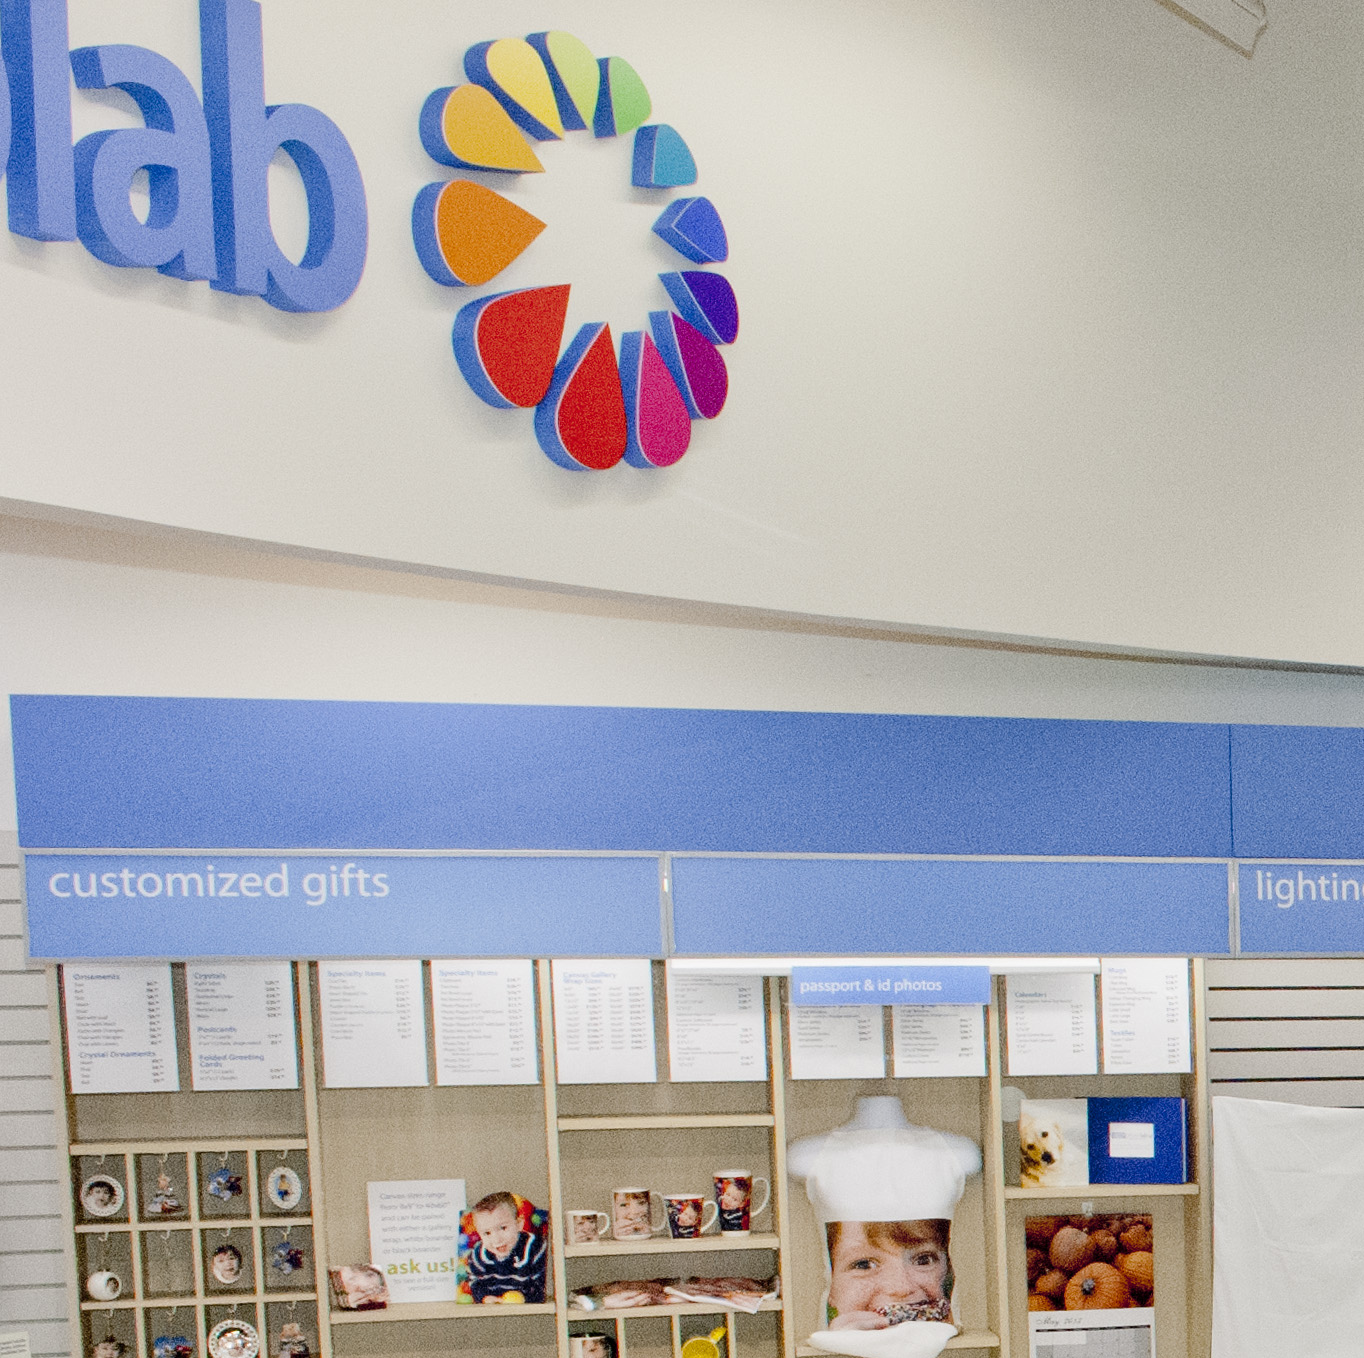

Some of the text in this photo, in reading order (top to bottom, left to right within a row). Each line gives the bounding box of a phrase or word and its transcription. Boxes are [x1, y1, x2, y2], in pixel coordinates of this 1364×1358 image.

[0, 0, 369, 314] lab
[49, 863, 390, 906] customized gifts
[799, 978, 943, 995] passport & id photos
[387, 1257, 455, 1276] ask us!
